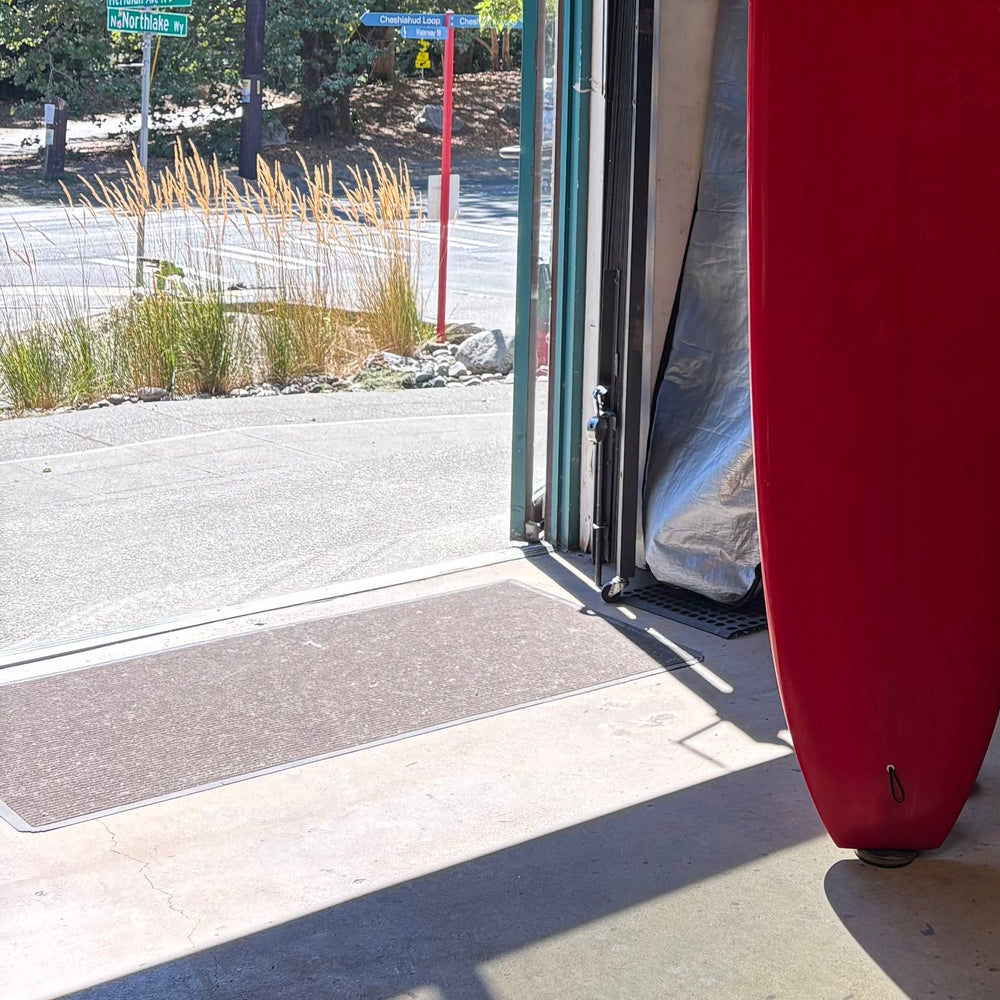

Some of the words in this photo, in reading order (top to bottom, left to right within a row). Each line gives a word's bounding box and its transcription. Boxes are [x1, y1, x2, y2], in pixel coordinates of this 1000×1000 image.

[110, 15, 117, 28] N
[122, 11, 170, 32] Northlake
[173, 20, 185, 35] Wy
[422, 15, 441, 26] Loop
